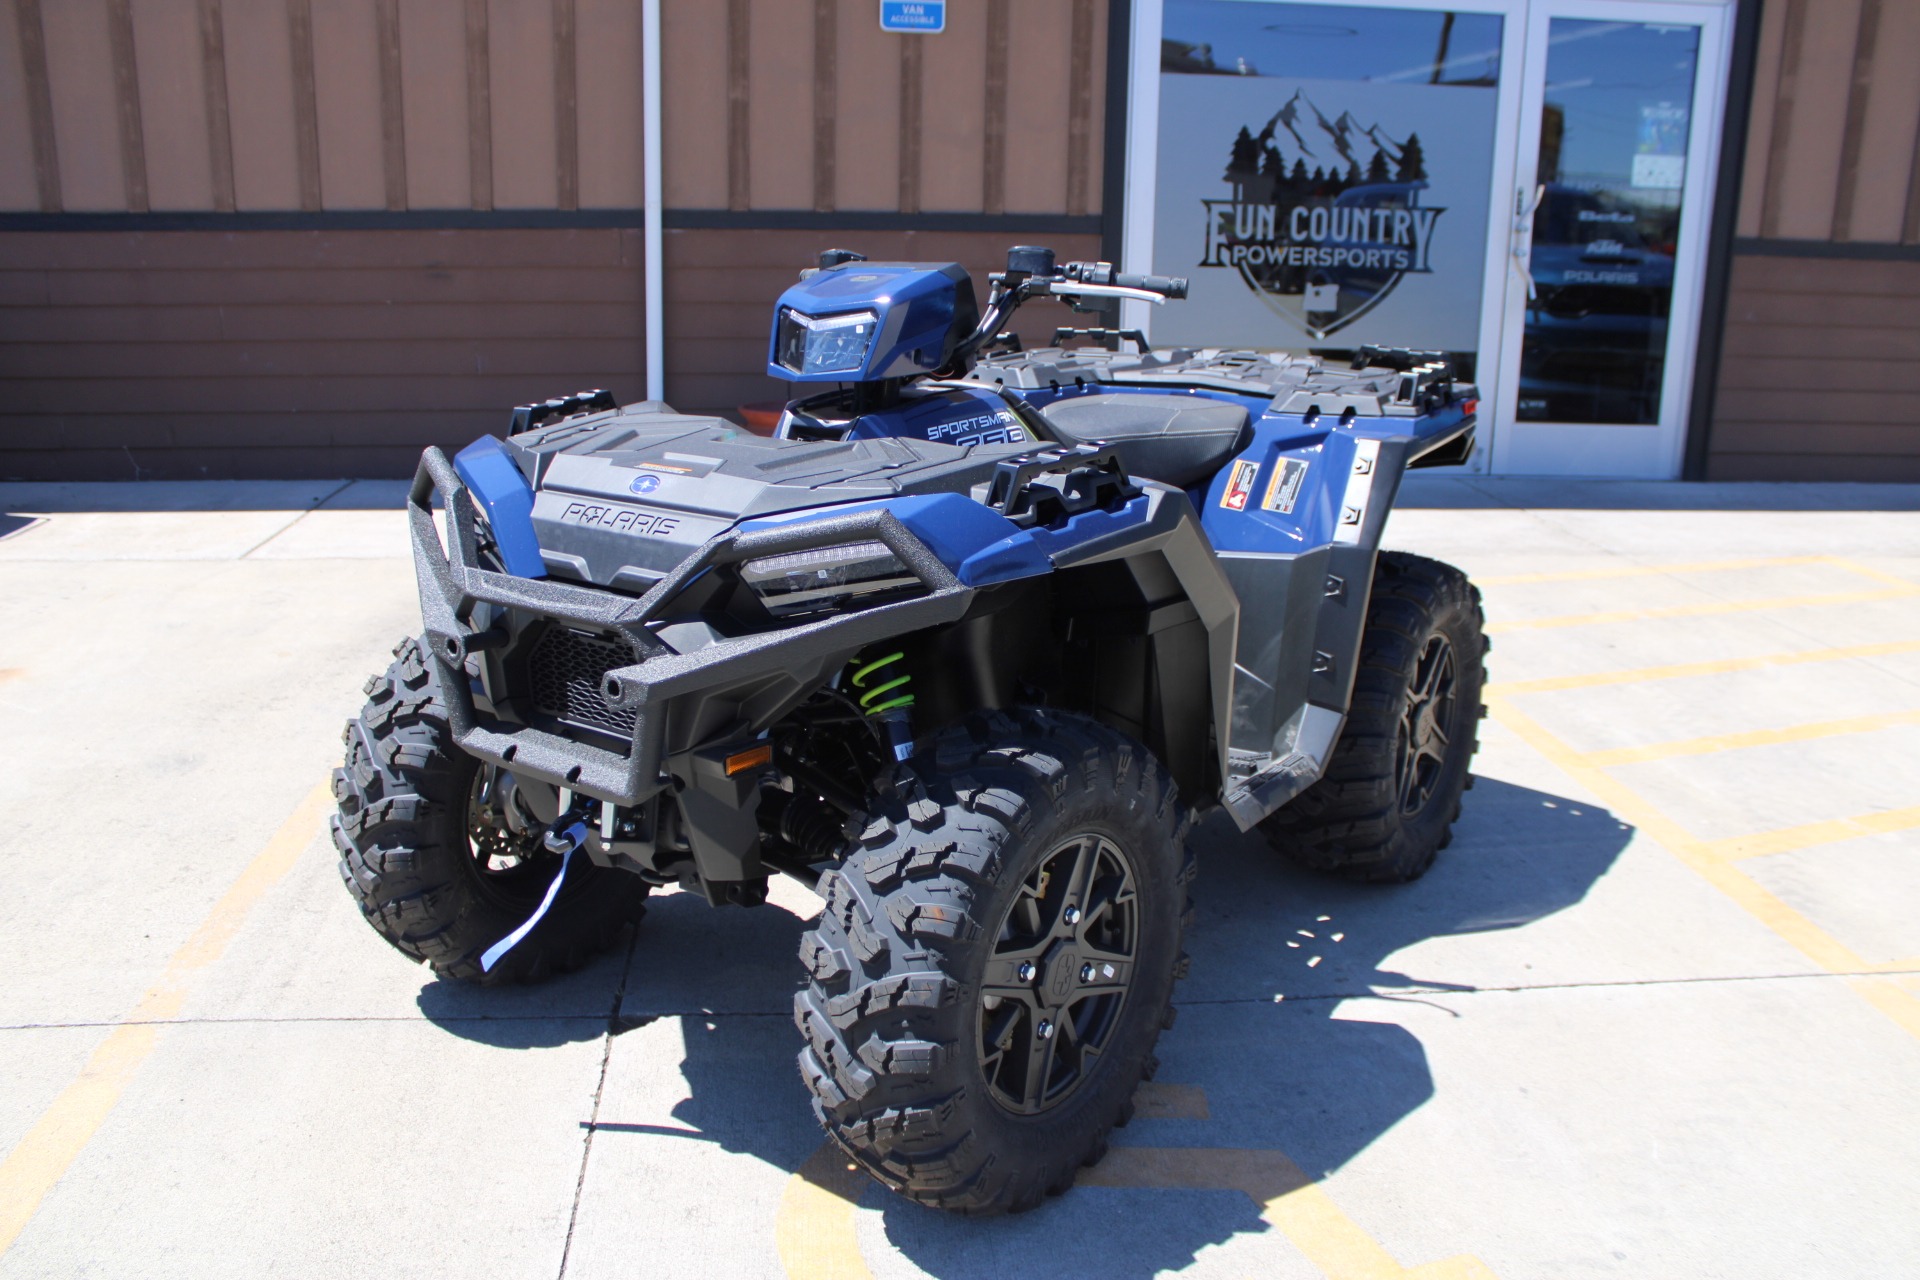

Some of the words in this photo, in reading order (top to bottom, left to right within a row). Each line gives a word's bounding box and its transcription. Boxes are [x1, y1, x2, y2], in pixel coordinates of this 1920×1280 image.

[890, 14, 935, 24] ACCESSIBLE
[902, 4, 925, 14] VAN
[1207, 203, 1276, 264] FUN
[1290, 206, 1435, 270] COUNTRY
[1232, 245, 1409, 269] POWERSPORTS
[1563, 270, 1639, 284] POLARIS
[927, 411, 1016, 440] SPORTSMAN
[561, 502, 680, 535] POLARIS
